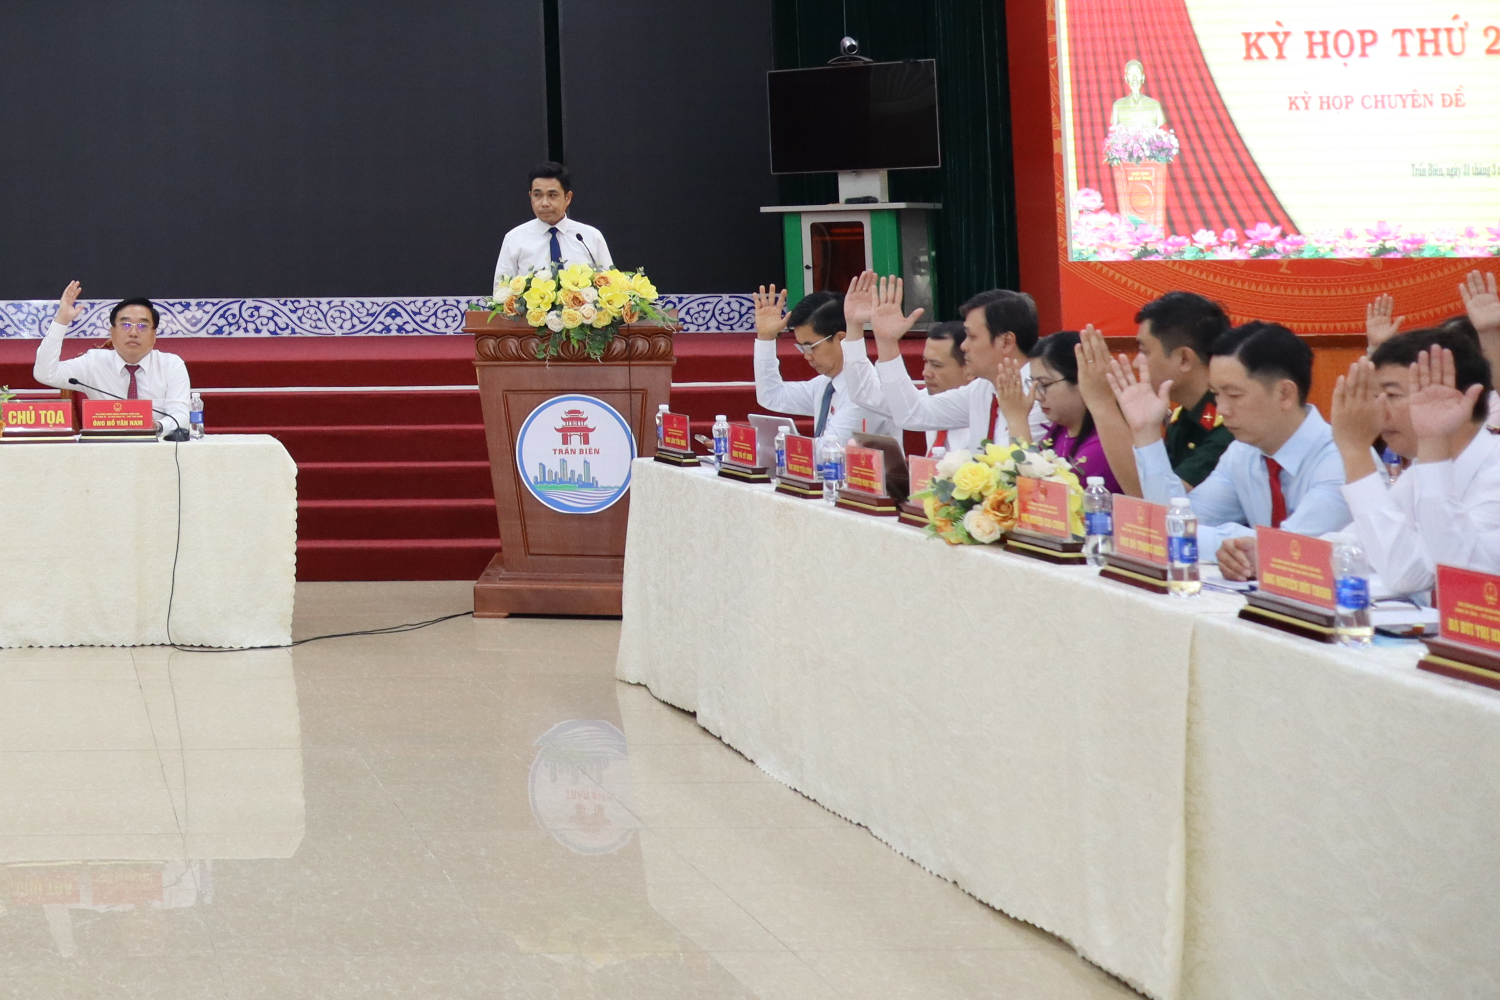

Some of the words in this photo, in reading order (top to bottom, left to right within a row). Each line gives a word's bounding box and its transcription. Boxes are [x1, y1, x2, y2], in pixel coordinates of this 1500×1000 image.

[1242, 20, 1292, 61] KỲ
[1304, 28, 1379, 67] HỌP
[1391, 14, 1470, 57] THỨ
[1484, 26, 1500, 55] 2
[1287, 90, 1313, 112] KỲ
[1318, 95, 1355, 114] HỌP
[1361, 88, 1435, 109] CHUYÊN
[1441, 84, 1467, 108] ĐỀ
[8, 406, 36, 425] CHỦ
[39, 410, 65, 427] TỌA
[552, 446, 577, 455] TRẤN
[579, 447, 600, 455] BIÊN
